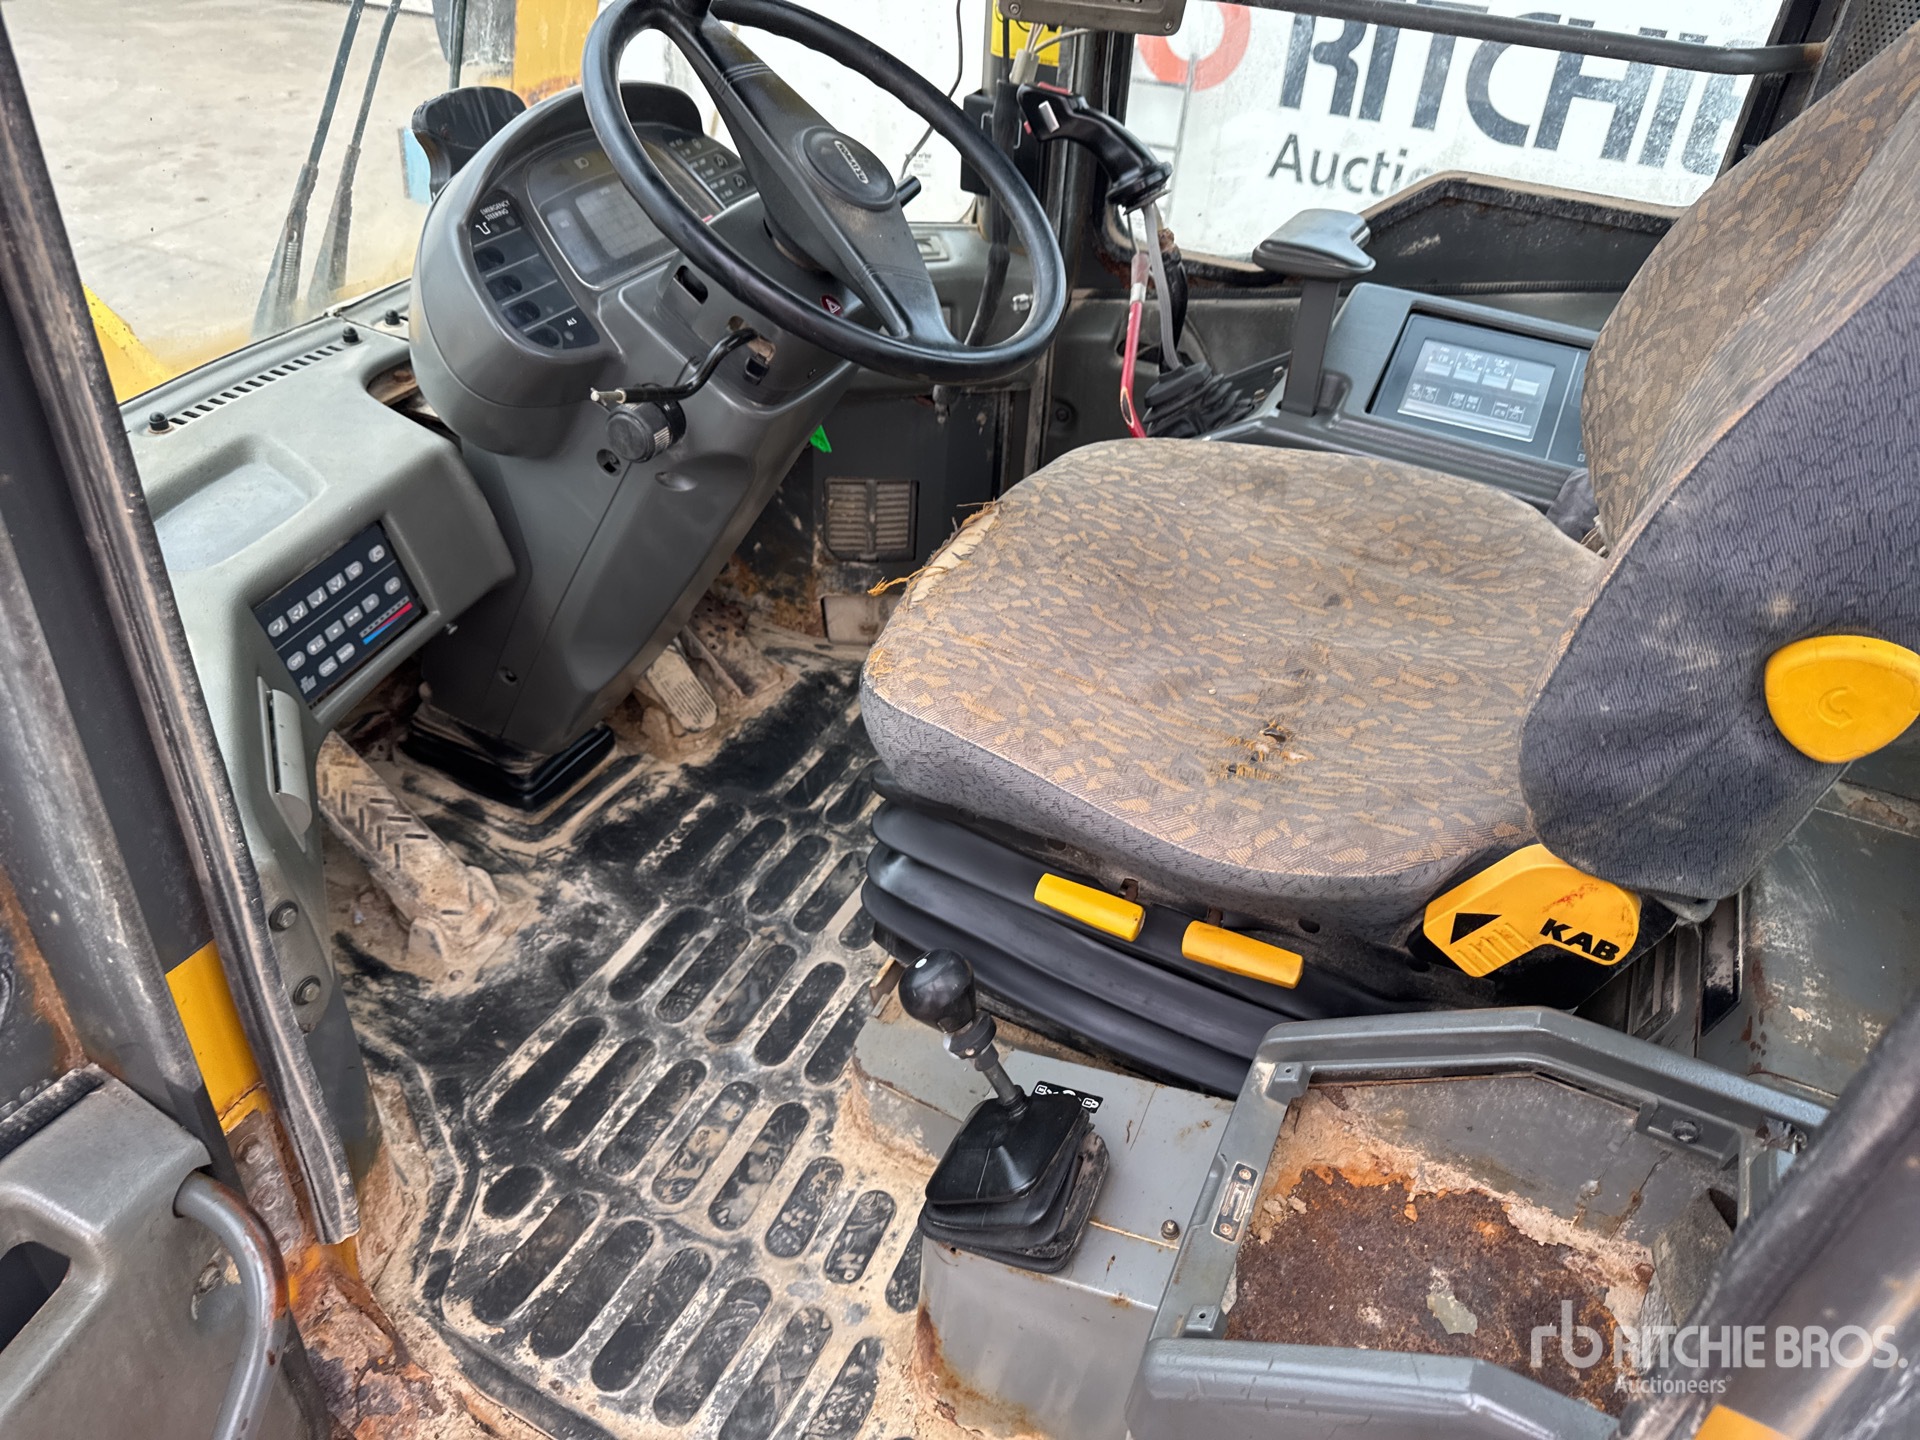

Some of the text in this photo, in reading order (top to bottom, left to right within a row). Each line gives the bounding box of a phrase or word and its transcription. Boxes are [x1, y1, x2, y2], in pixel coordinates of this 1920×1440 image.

[480, 199, 510, 216] EMERGENCY
[484, 208, 509, 221] STEERING
[566, 317, 577, 327] ALS
[1540, 917, 1620, 962] KAB
